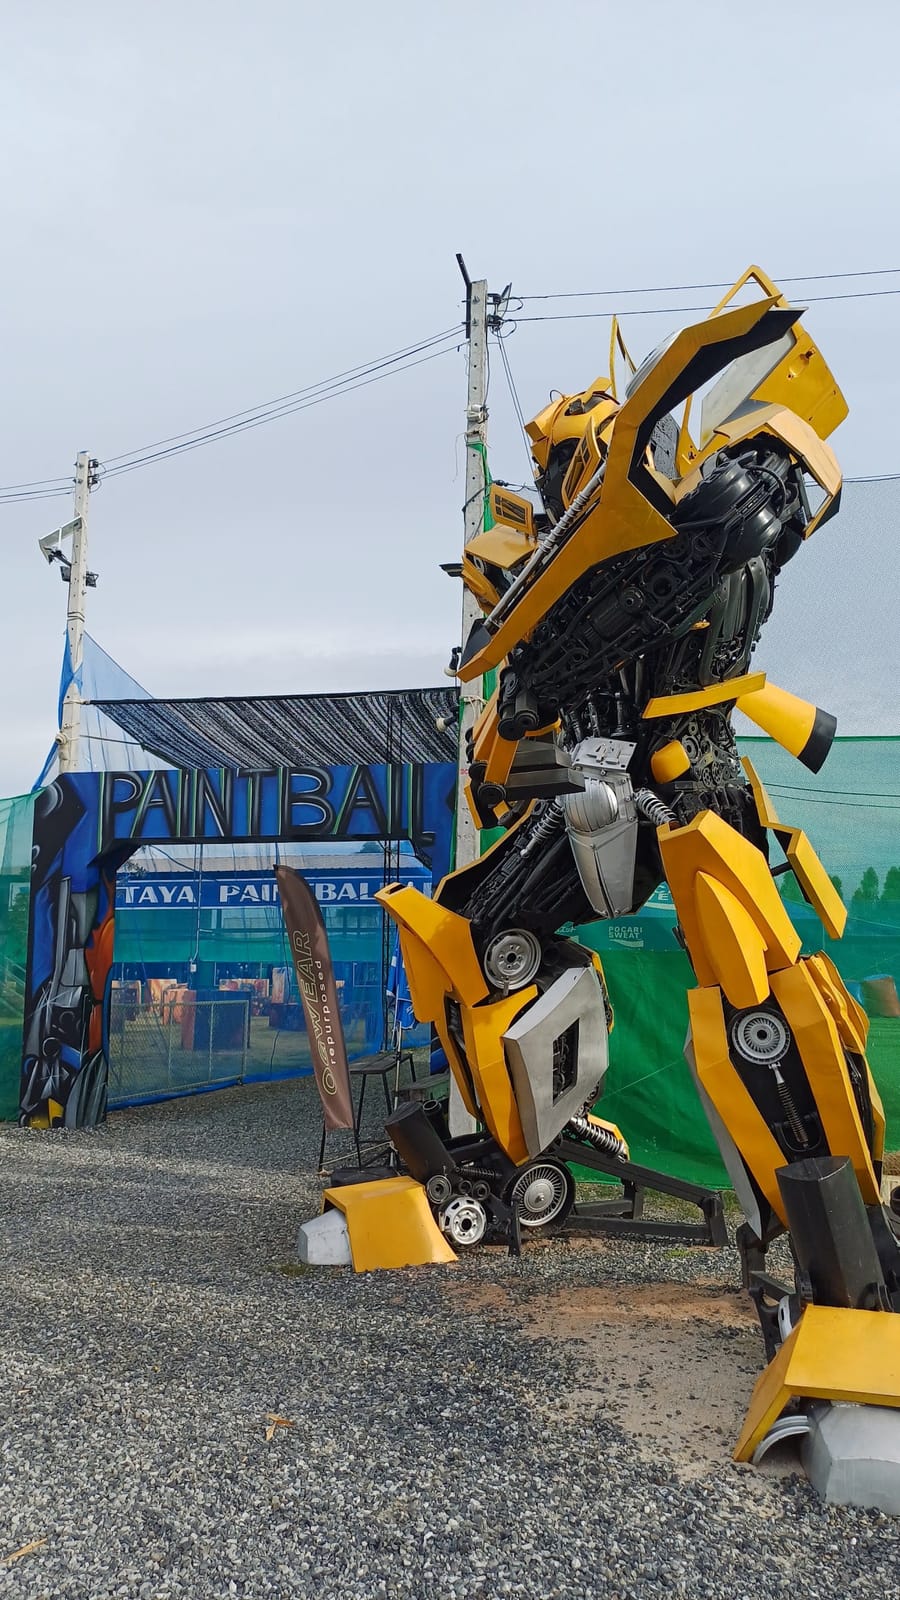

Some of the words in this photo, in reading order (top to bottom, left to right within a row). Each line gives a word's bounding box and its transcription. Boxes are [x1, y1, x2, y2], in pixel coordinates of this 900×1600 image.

[100, 763, 436, 846] PAINTBALL
[116, 885, 197, 904] TAYA
[219, 882, 387, 903] PAIBAL
[315, 960, 336, 1065] repurposed
